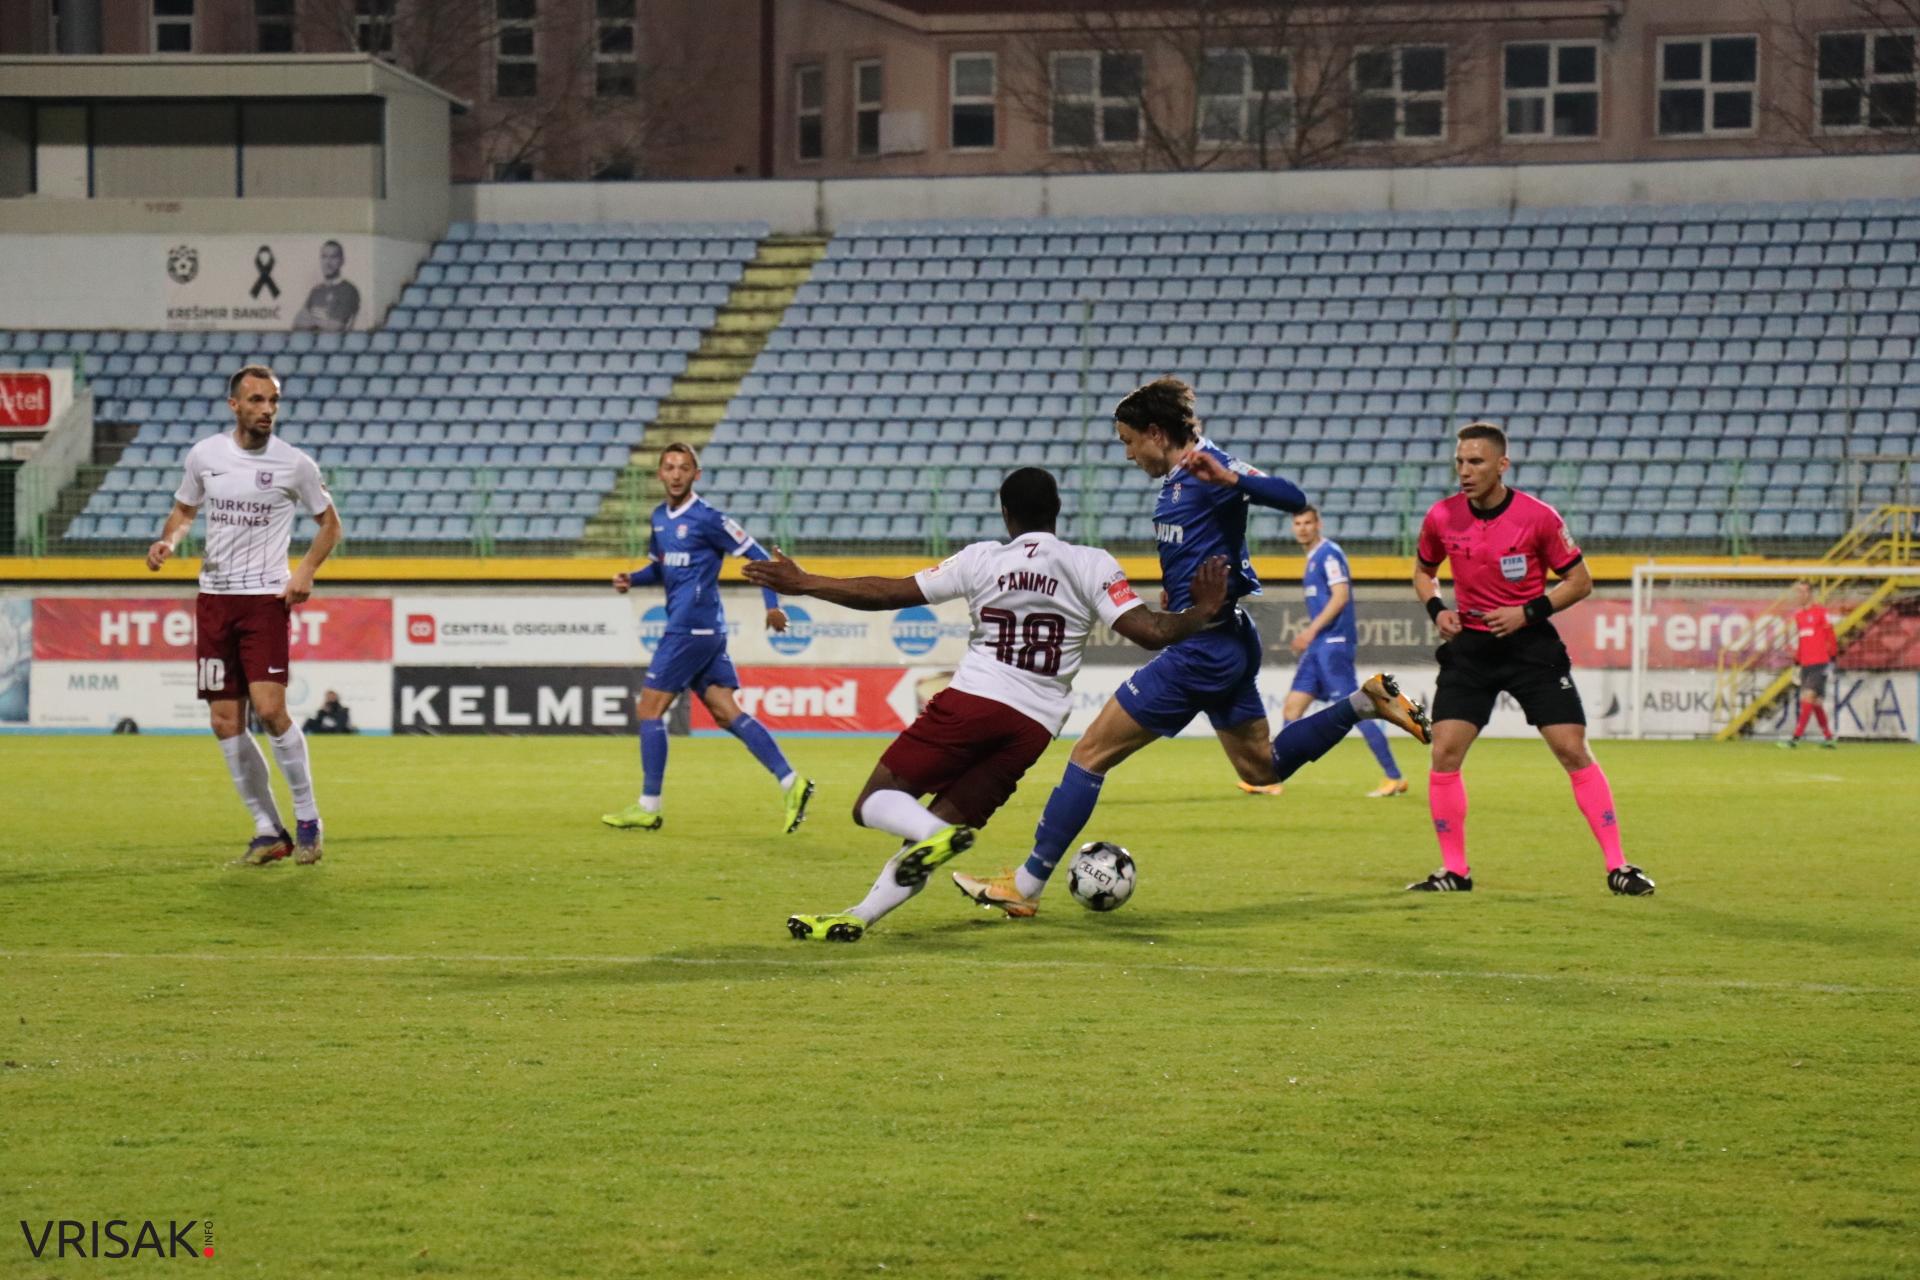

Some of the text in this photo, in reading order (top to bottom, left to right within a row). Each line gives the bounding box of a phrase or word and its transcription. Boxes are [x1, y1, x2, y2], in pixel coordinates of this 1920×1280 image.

[166, 305, 281, 320] KREŠIMIR BANDIĆ
[210, 498, 272, 514] TURKISH
[210, 512, 272, 527] AIRLINES
[1502, 556, 1525, 566] FIFA
[997, 571, 1059, 598] FANIMO
[441, 622, 508, 636] CENTRAL
[68, 673, 120, 691] MRM
[198, 657, 225, 692] 10
[400, 685, 629, 727] KELME
[1079, 861, 1112, 886] SELECT
